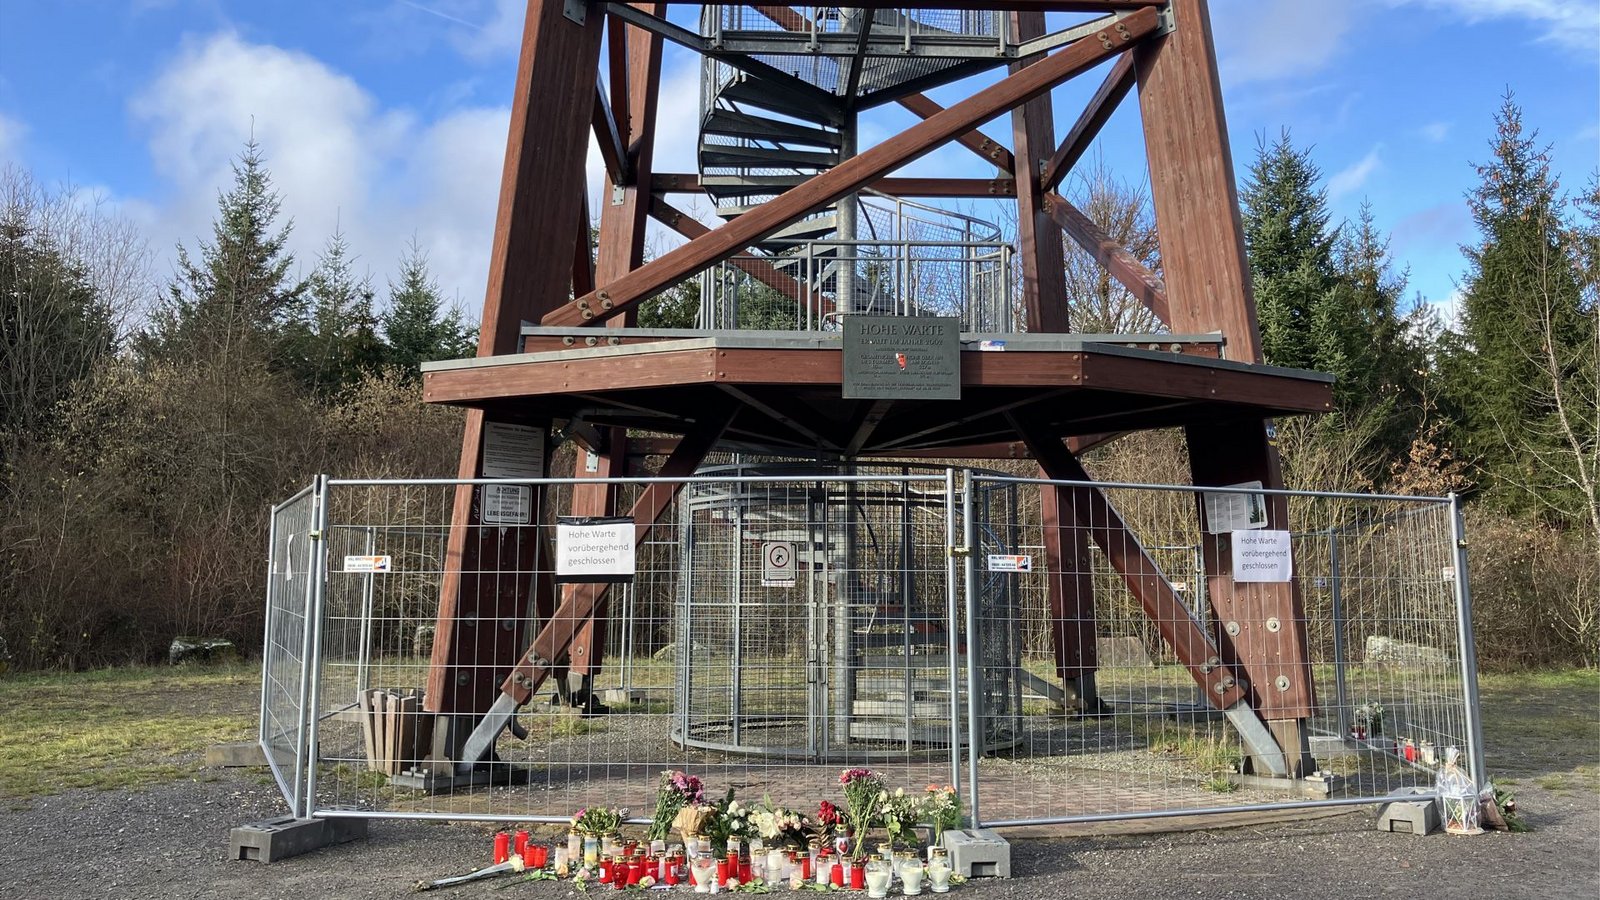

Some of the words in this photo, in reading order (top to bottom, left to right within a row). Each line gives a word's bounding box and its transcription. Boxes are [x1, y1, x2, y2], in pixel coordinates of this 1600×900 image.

[860, 325, 898, 336] HOHE
[902, 325, 944, 336] WARTE
[568, 531, 590, 539] Hohe
[591, 530, 617, 538] Warte
[1241, 537, 1257, 545] Hohe
[1258, 537, 1278, 545] Warte
[568, 543, 629, 553] vorübergehend
[1241, 550, 1287, 559] vorübergehend
[568, 557, 616, 567] geschlossen
[1241, 562, 1279, 571] geschlossen
